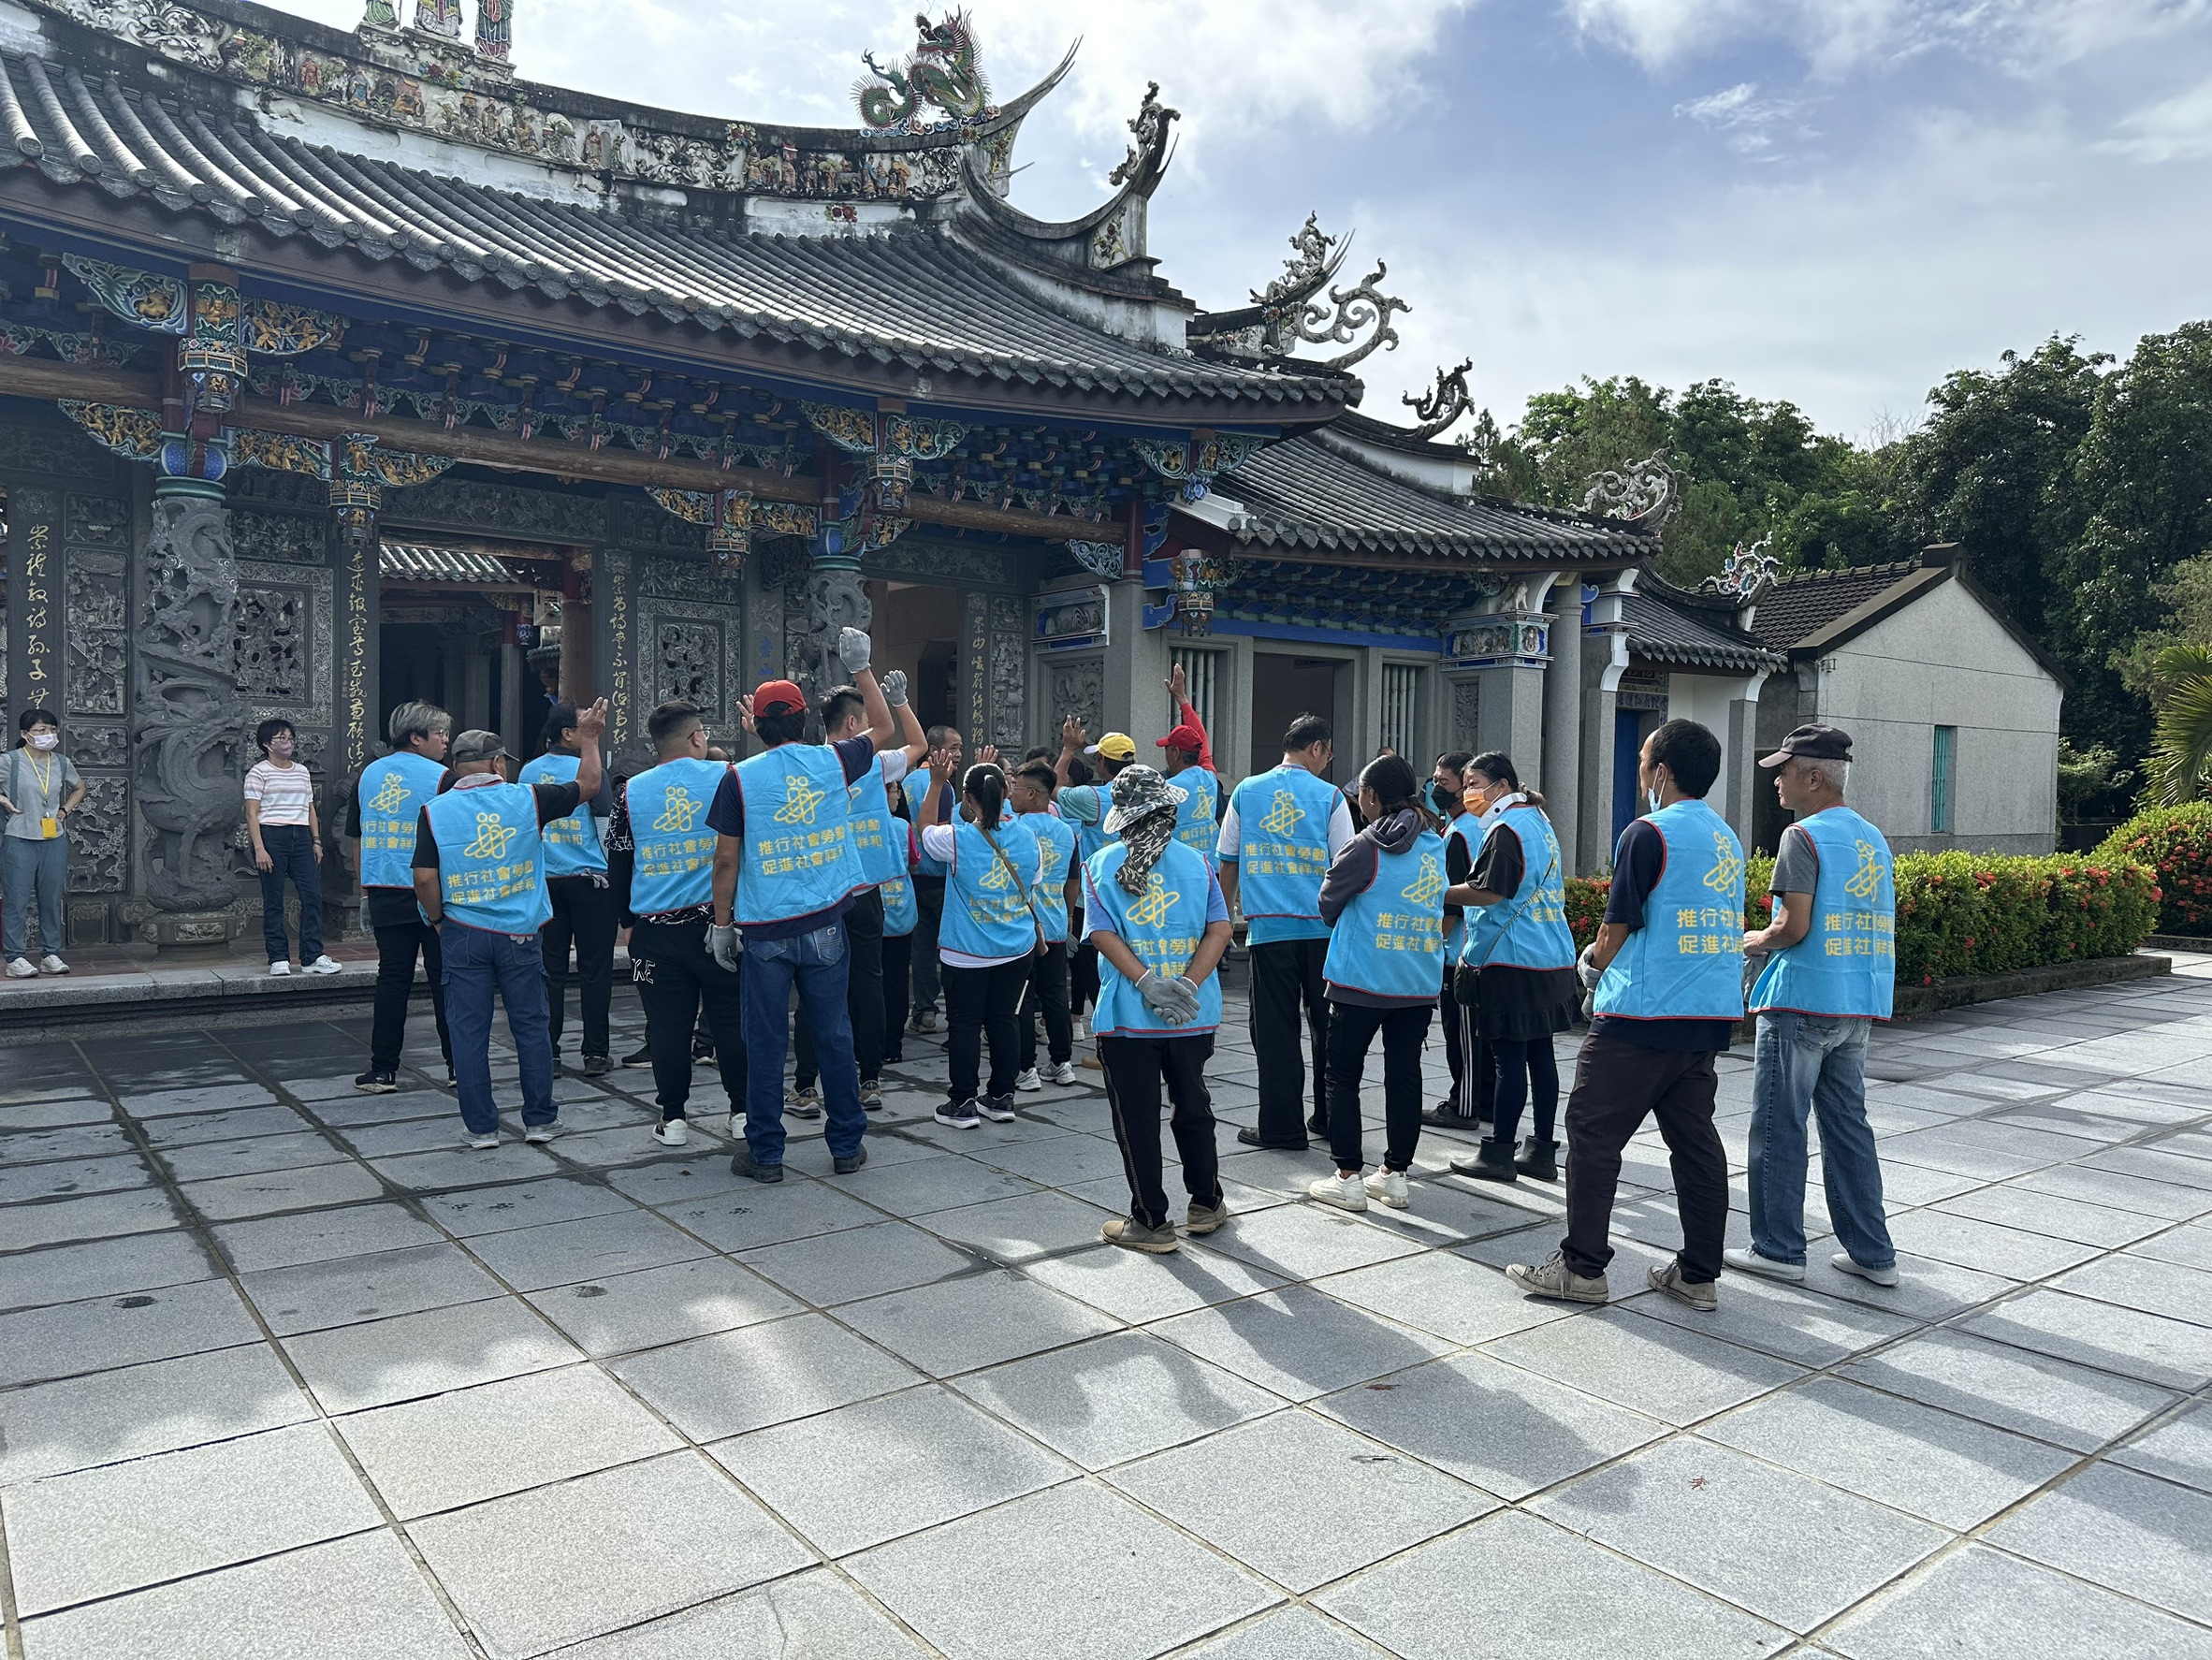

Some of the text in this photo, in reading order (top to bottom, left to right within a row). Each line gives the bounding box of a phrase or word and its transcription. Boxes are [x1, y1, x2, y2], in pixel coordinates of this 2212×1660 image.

[1245, 842, 1327, 861] 推行社會勞動
[447, 859, 533, 888] 推行社會勞動
[1247, 860, 1327, 876] 促進社會祥和
[451, 876, 536, 905] 促進社會祥和
[1128, 937, 1199, 955] 行社會勞動
